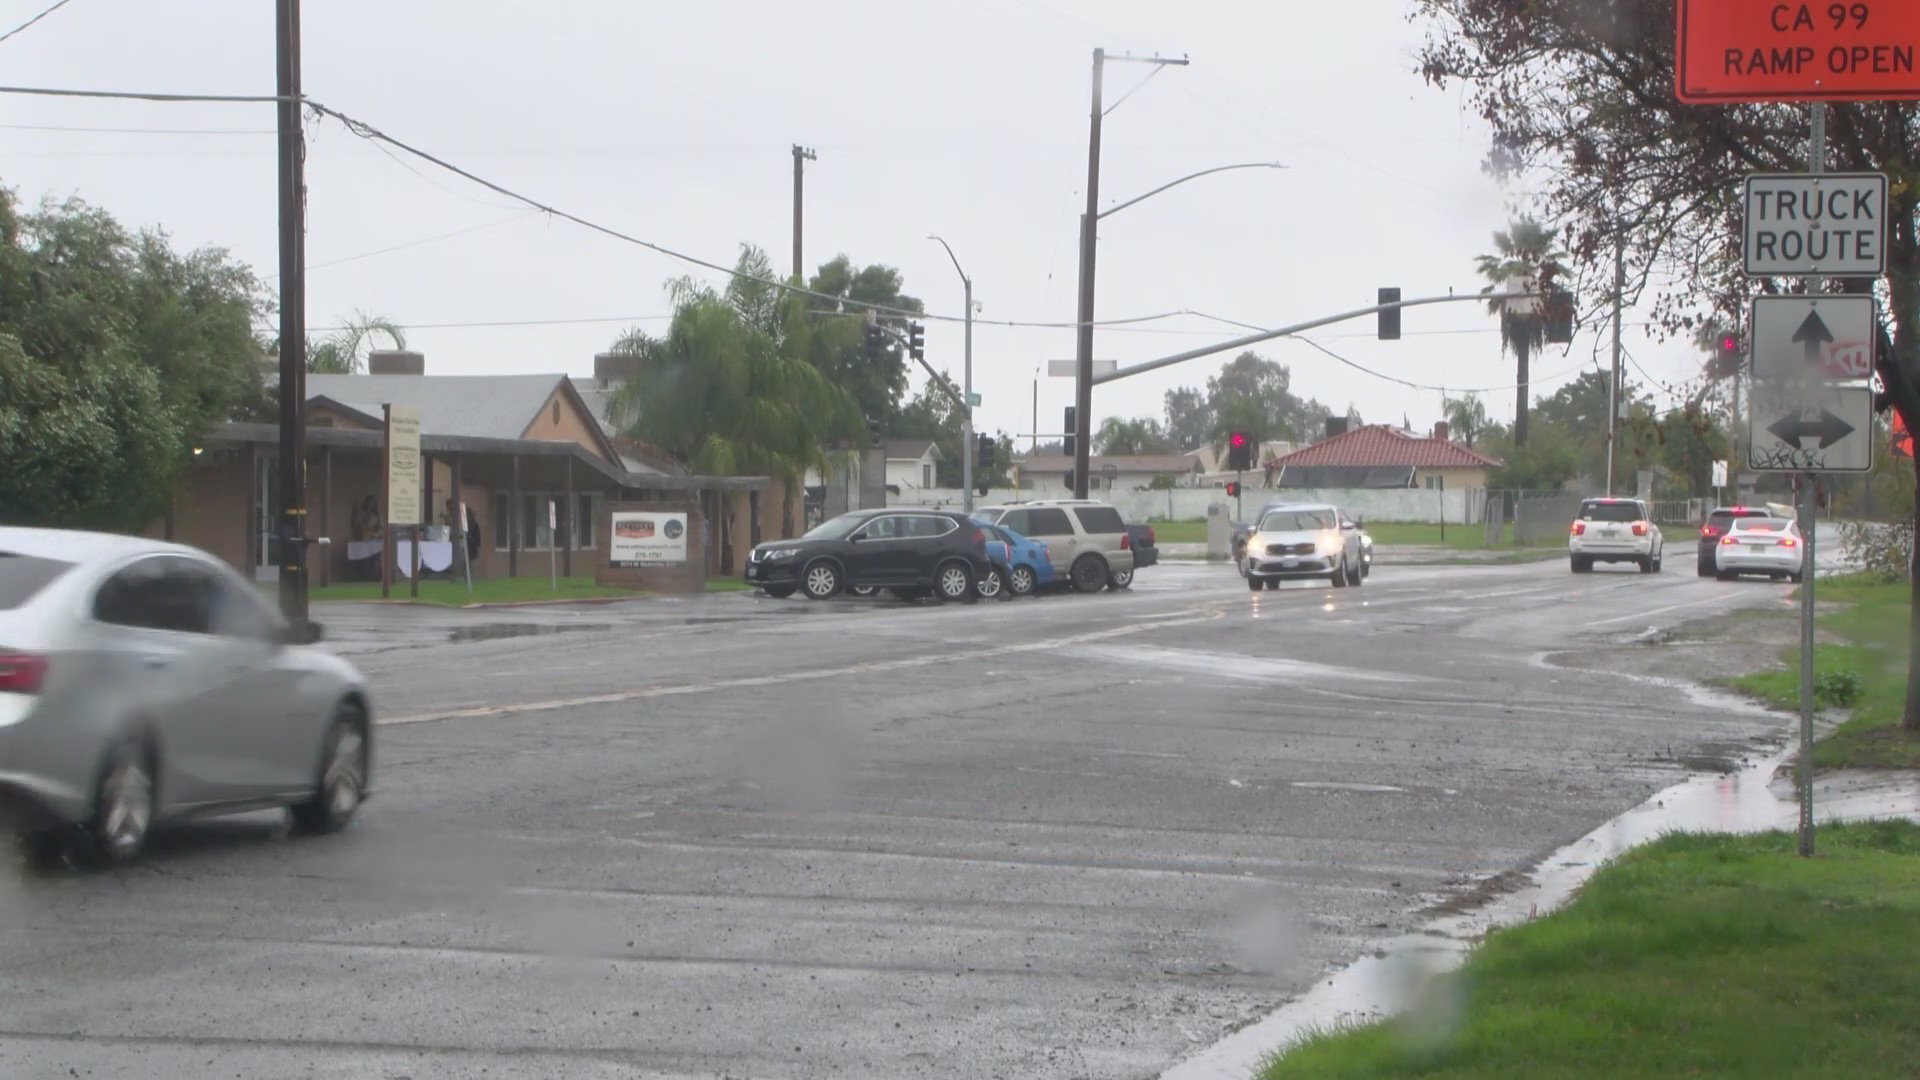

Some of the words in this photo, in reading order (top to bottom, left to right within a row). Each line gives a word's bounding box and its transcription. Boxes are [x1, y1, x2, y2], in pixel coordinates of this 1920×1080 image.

[1770, 4, 1815, 32] CA
[1827, 3, 1869, 30] 99
[1724, 47, 1815, 75] RAMP
[1827, 45, 1913, 74] OPEN
[1754, 189, 1874, 220] TRUCK
[1756, 230, 1875, 261] ROUTE
